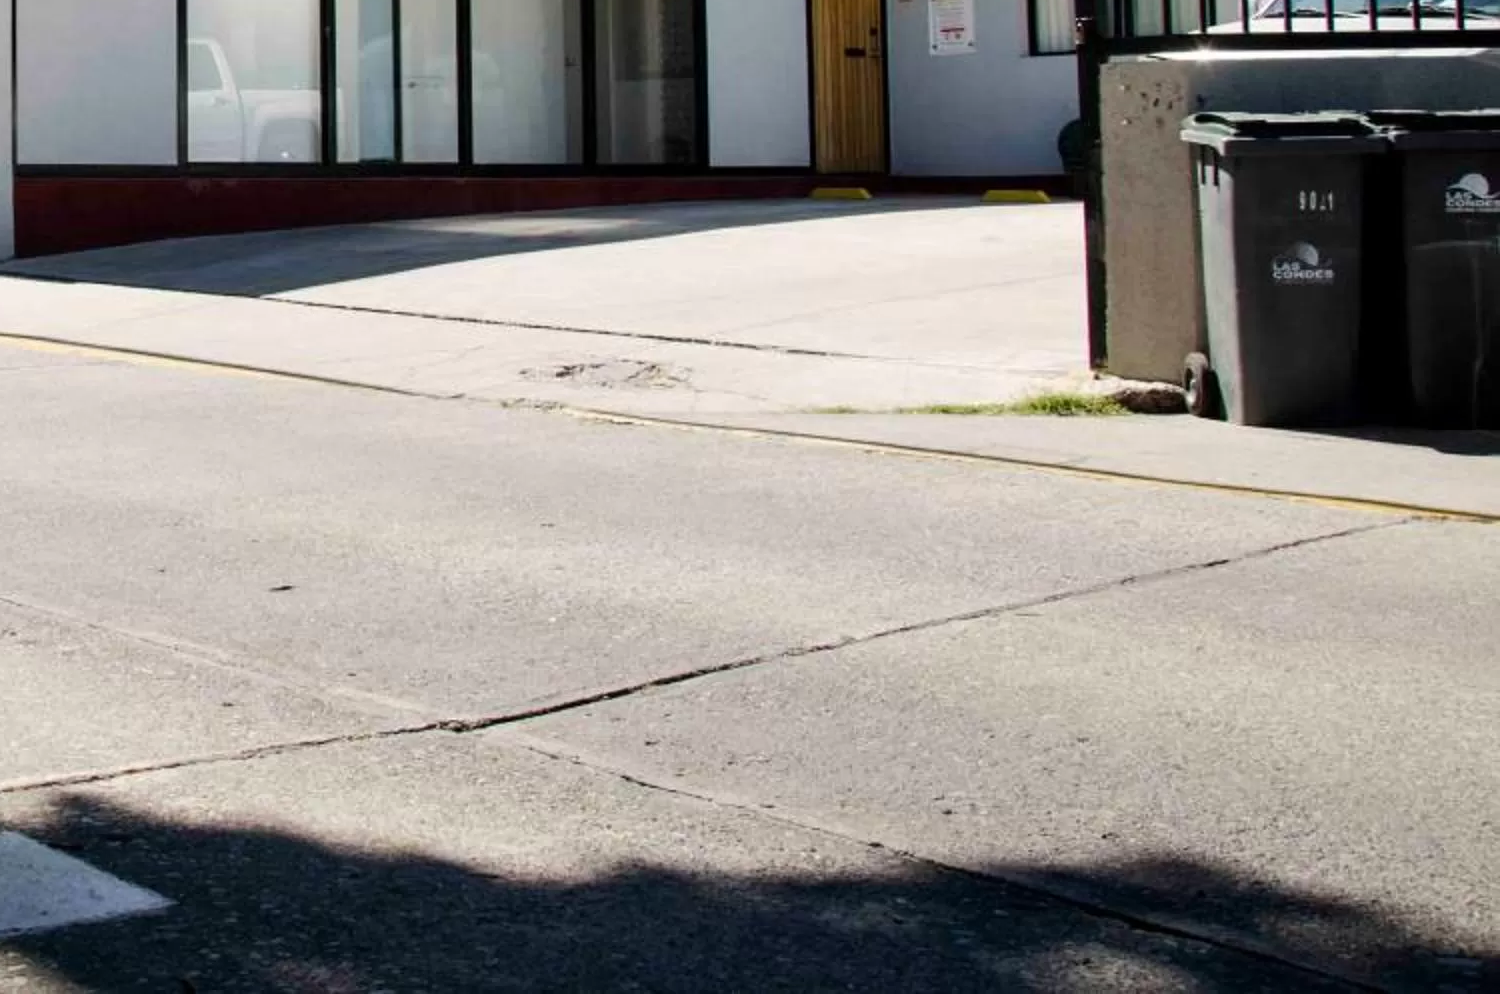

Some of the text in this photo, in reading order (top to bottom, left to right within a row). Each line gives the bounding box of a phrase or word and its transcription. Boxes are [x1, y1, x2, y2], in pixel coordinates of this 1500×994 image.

[1445, 191, 1473, 200] LAS
[1272, 260, 1301, 271] LAS
[1272, 269, 1335, 279] CONDES
